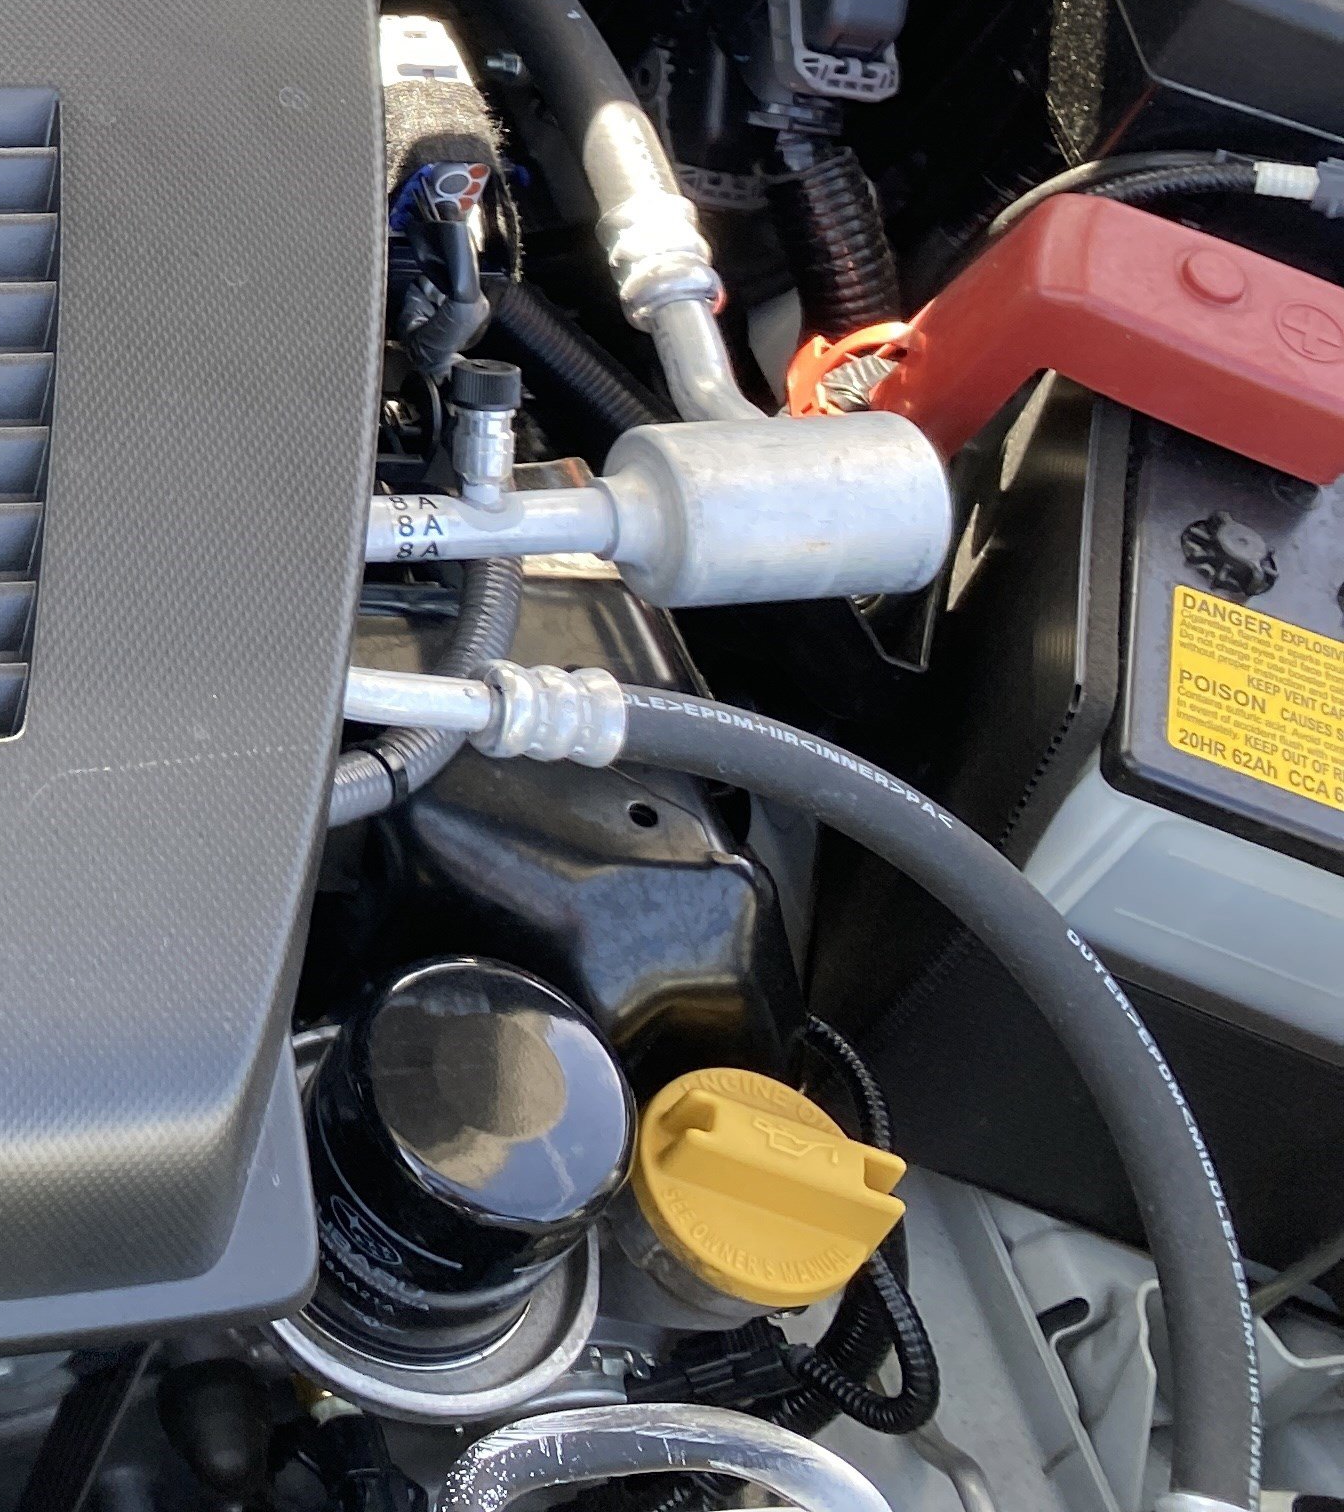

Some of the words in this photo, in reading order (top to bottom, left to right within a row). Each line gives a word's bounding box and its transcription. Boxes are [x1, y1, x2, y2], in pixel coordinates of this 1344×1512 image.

[1182, 591, 1272, 639] DANGER
[1179, 666, 1265, 716] POISON
[1280, 706, 1331, 738] CAUSES
[1247, 675, 1280, 698] KEEP
[1284, 688, 1316, 711] VENT
[1179, 725, 1226, 761] 20HR
[1232, 745, 1277, 780] 62Ah
[1288, 767, 1329, 799] CCA
[1244, 733, 1277, 758] KEEP
[1281, 747, 1307, 769] OUT
[781, 1245, 853, 1286] MANUAL
